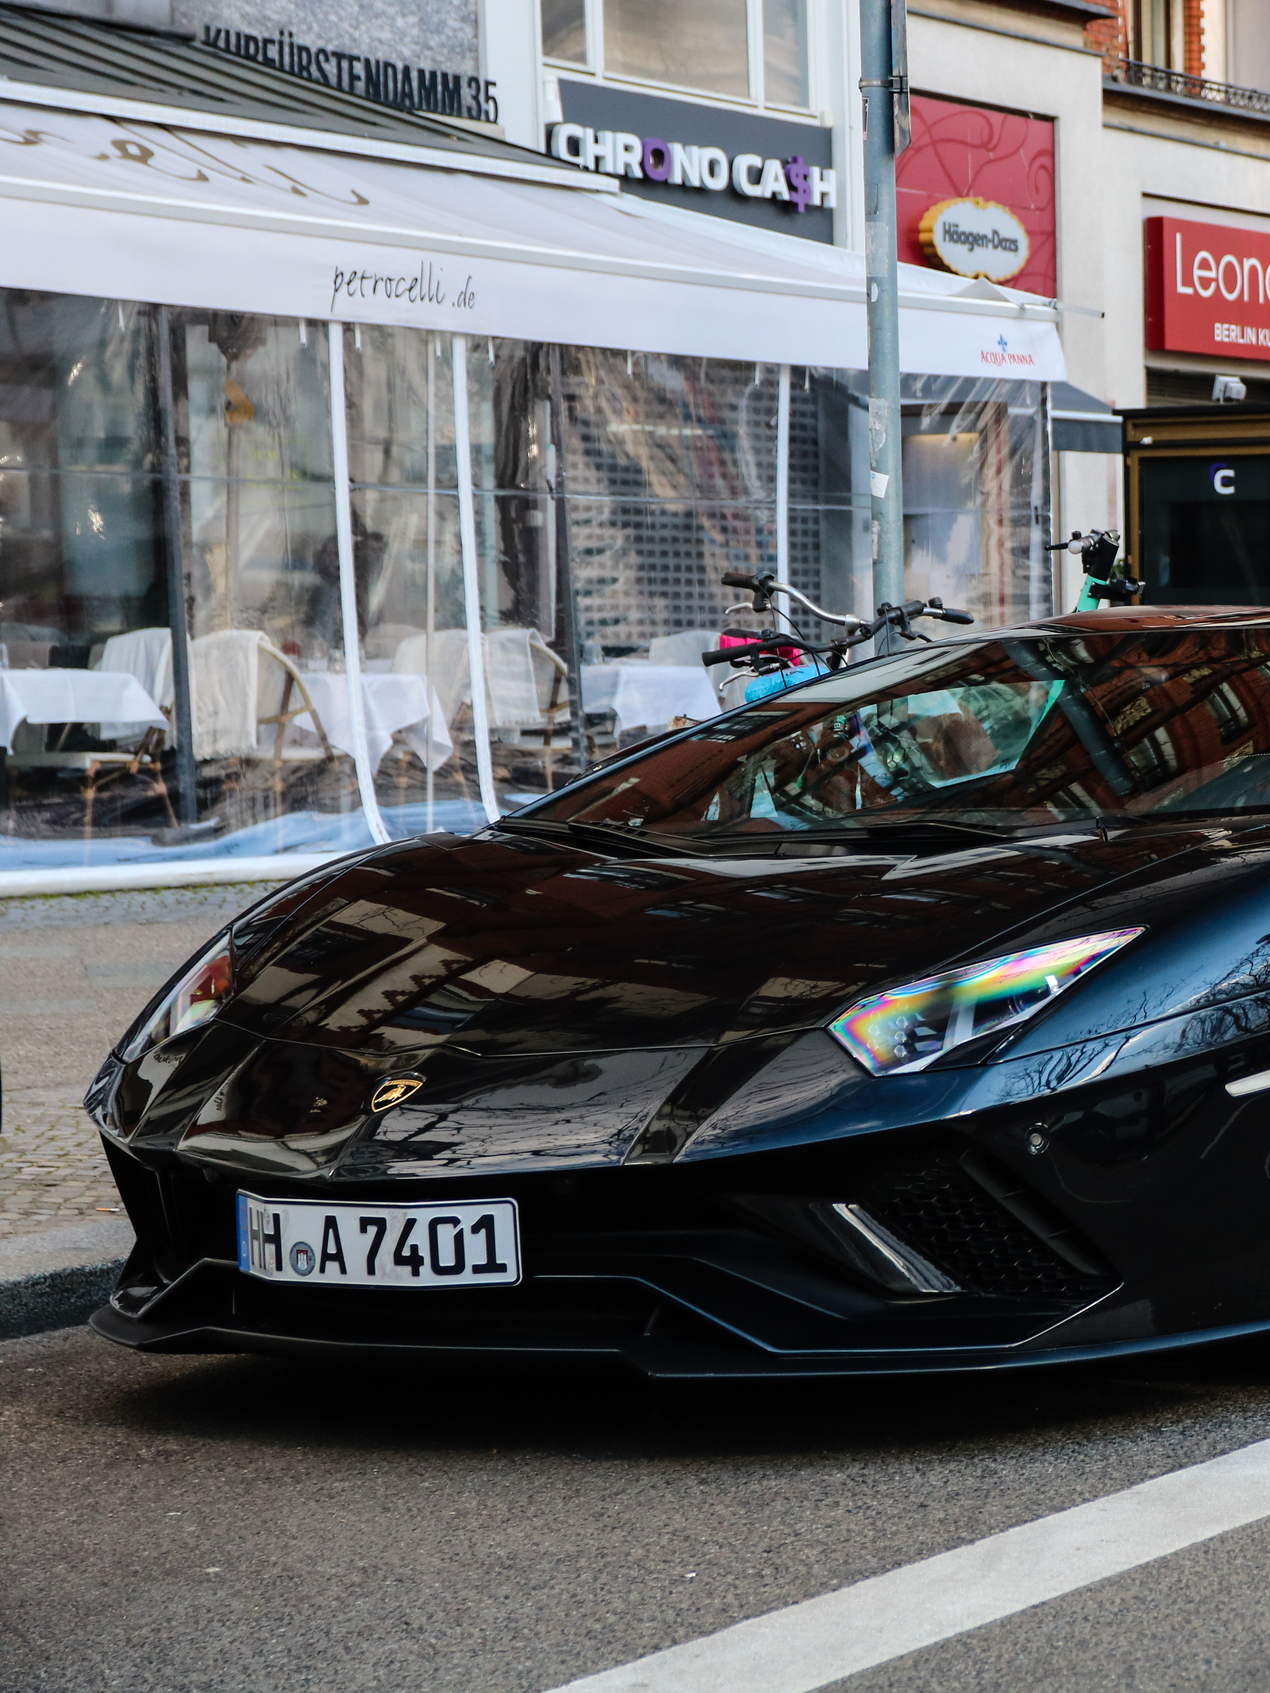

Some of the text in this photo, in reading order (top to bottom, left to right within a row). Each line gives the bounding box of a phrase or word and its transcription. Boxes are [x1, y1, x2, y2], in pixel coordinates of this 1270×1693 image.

[466, 77, 499, 123] 35
[551, 122, 730, 191] CHRONO
[942, 221, 1018, 252] Häagen-Dazs
[1214, 322, 1257, 345] BERLIN
[981, 351, 1035, 366] ACQUA PANNA
[319, 1215, 347, 1275] A
[359, 1213, 507, 1277] 7401
